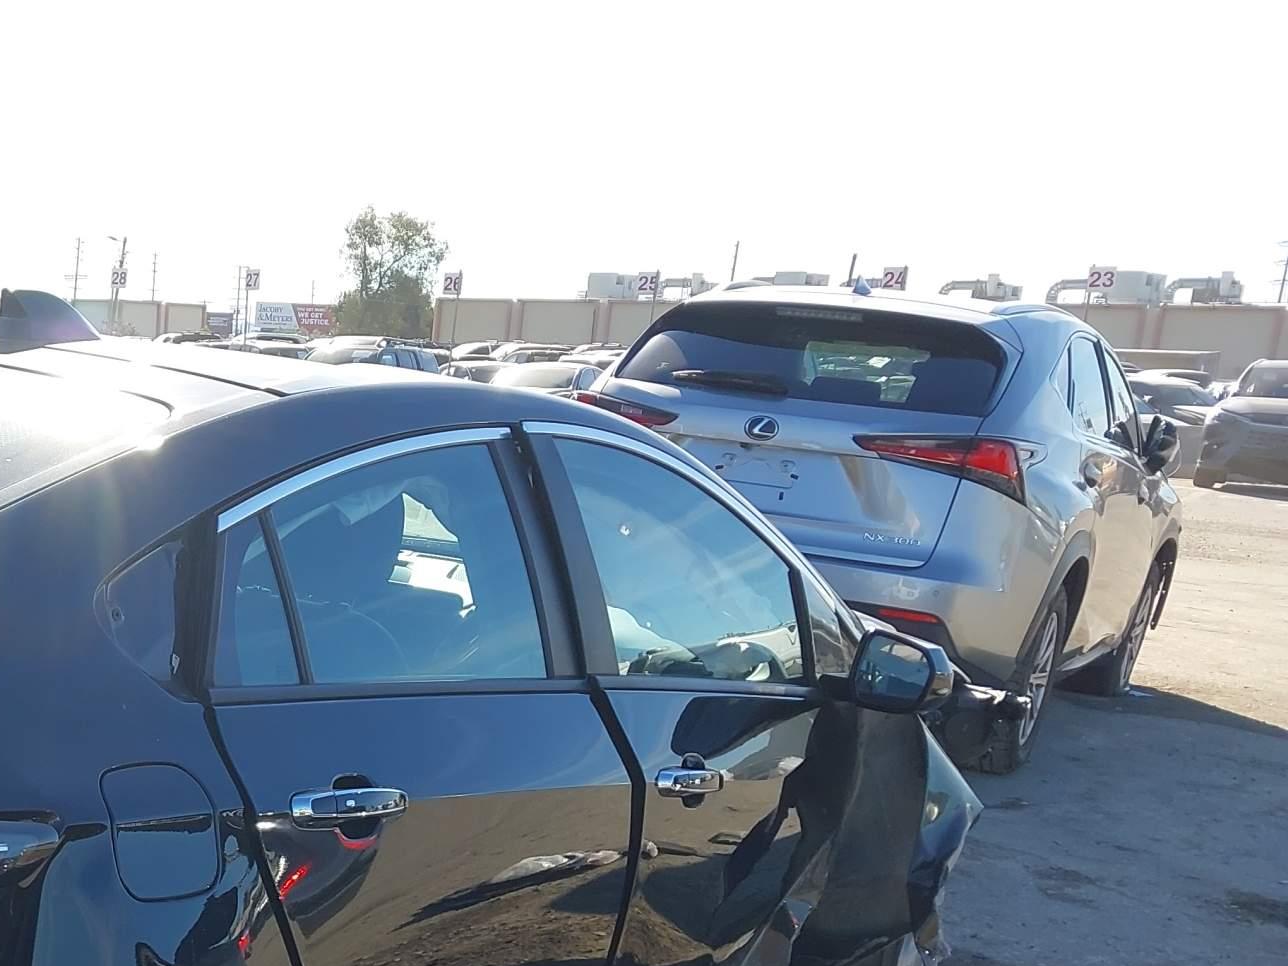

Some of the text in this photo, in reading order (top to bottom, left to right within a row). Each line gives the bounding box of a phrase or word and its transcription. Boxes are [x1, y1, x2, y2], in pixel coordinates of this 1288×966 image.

[111, 271, 128, 286] 28
[245, 272, 260, 288] 27
[443, 275, 460, 292] 26
[637, 275, 657, 291] 25
[883, 271, 905, 288] 24
[1088, 270, 1116, 288] 23
[297, 311, 310, 319] WE
[863, 532, 921, 547] NX 300
